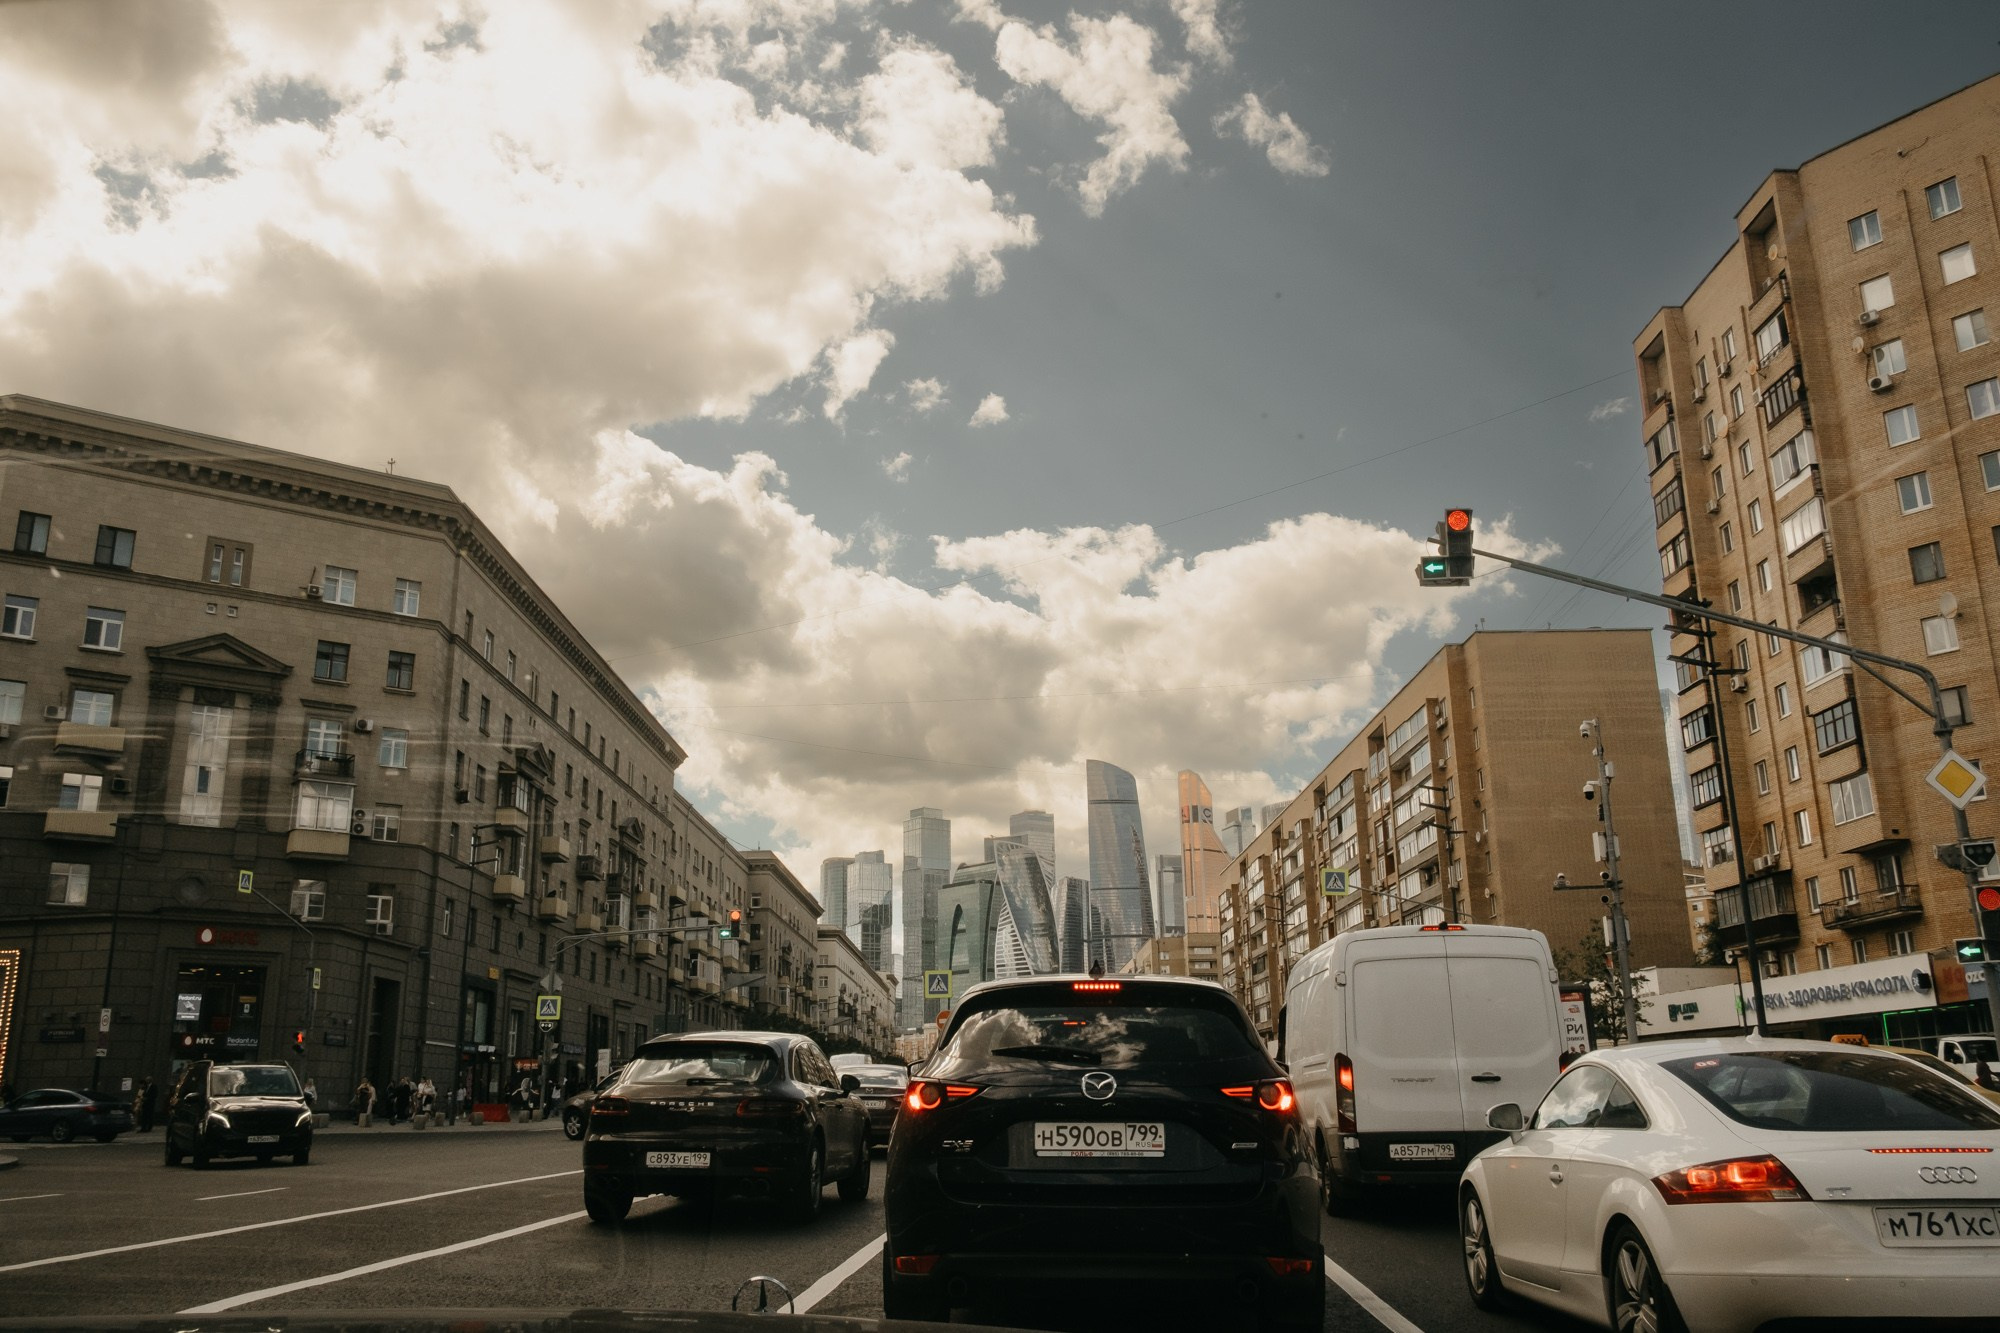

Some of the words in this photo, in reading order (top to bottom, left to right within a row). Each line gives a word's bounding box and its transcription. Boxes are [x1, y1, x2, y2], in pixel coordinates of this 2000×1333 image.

[1965, 970, 1986, 983] OZO
[1851, 975, 1909, 998] КРАСОТА
[196, 1037, 215, 1045] МТС
[1042, 1125, 1123, 1147] Н590ОВ
[1127, 1124, 1159, 1141] 799
[1435, 1144, 1452, 1153] 799
[649, 1153, 690, 1165] С893УЕ
[691, 1153, 708, 1162] 199
[1888, 1211, 1995, 1237] М761ХС
